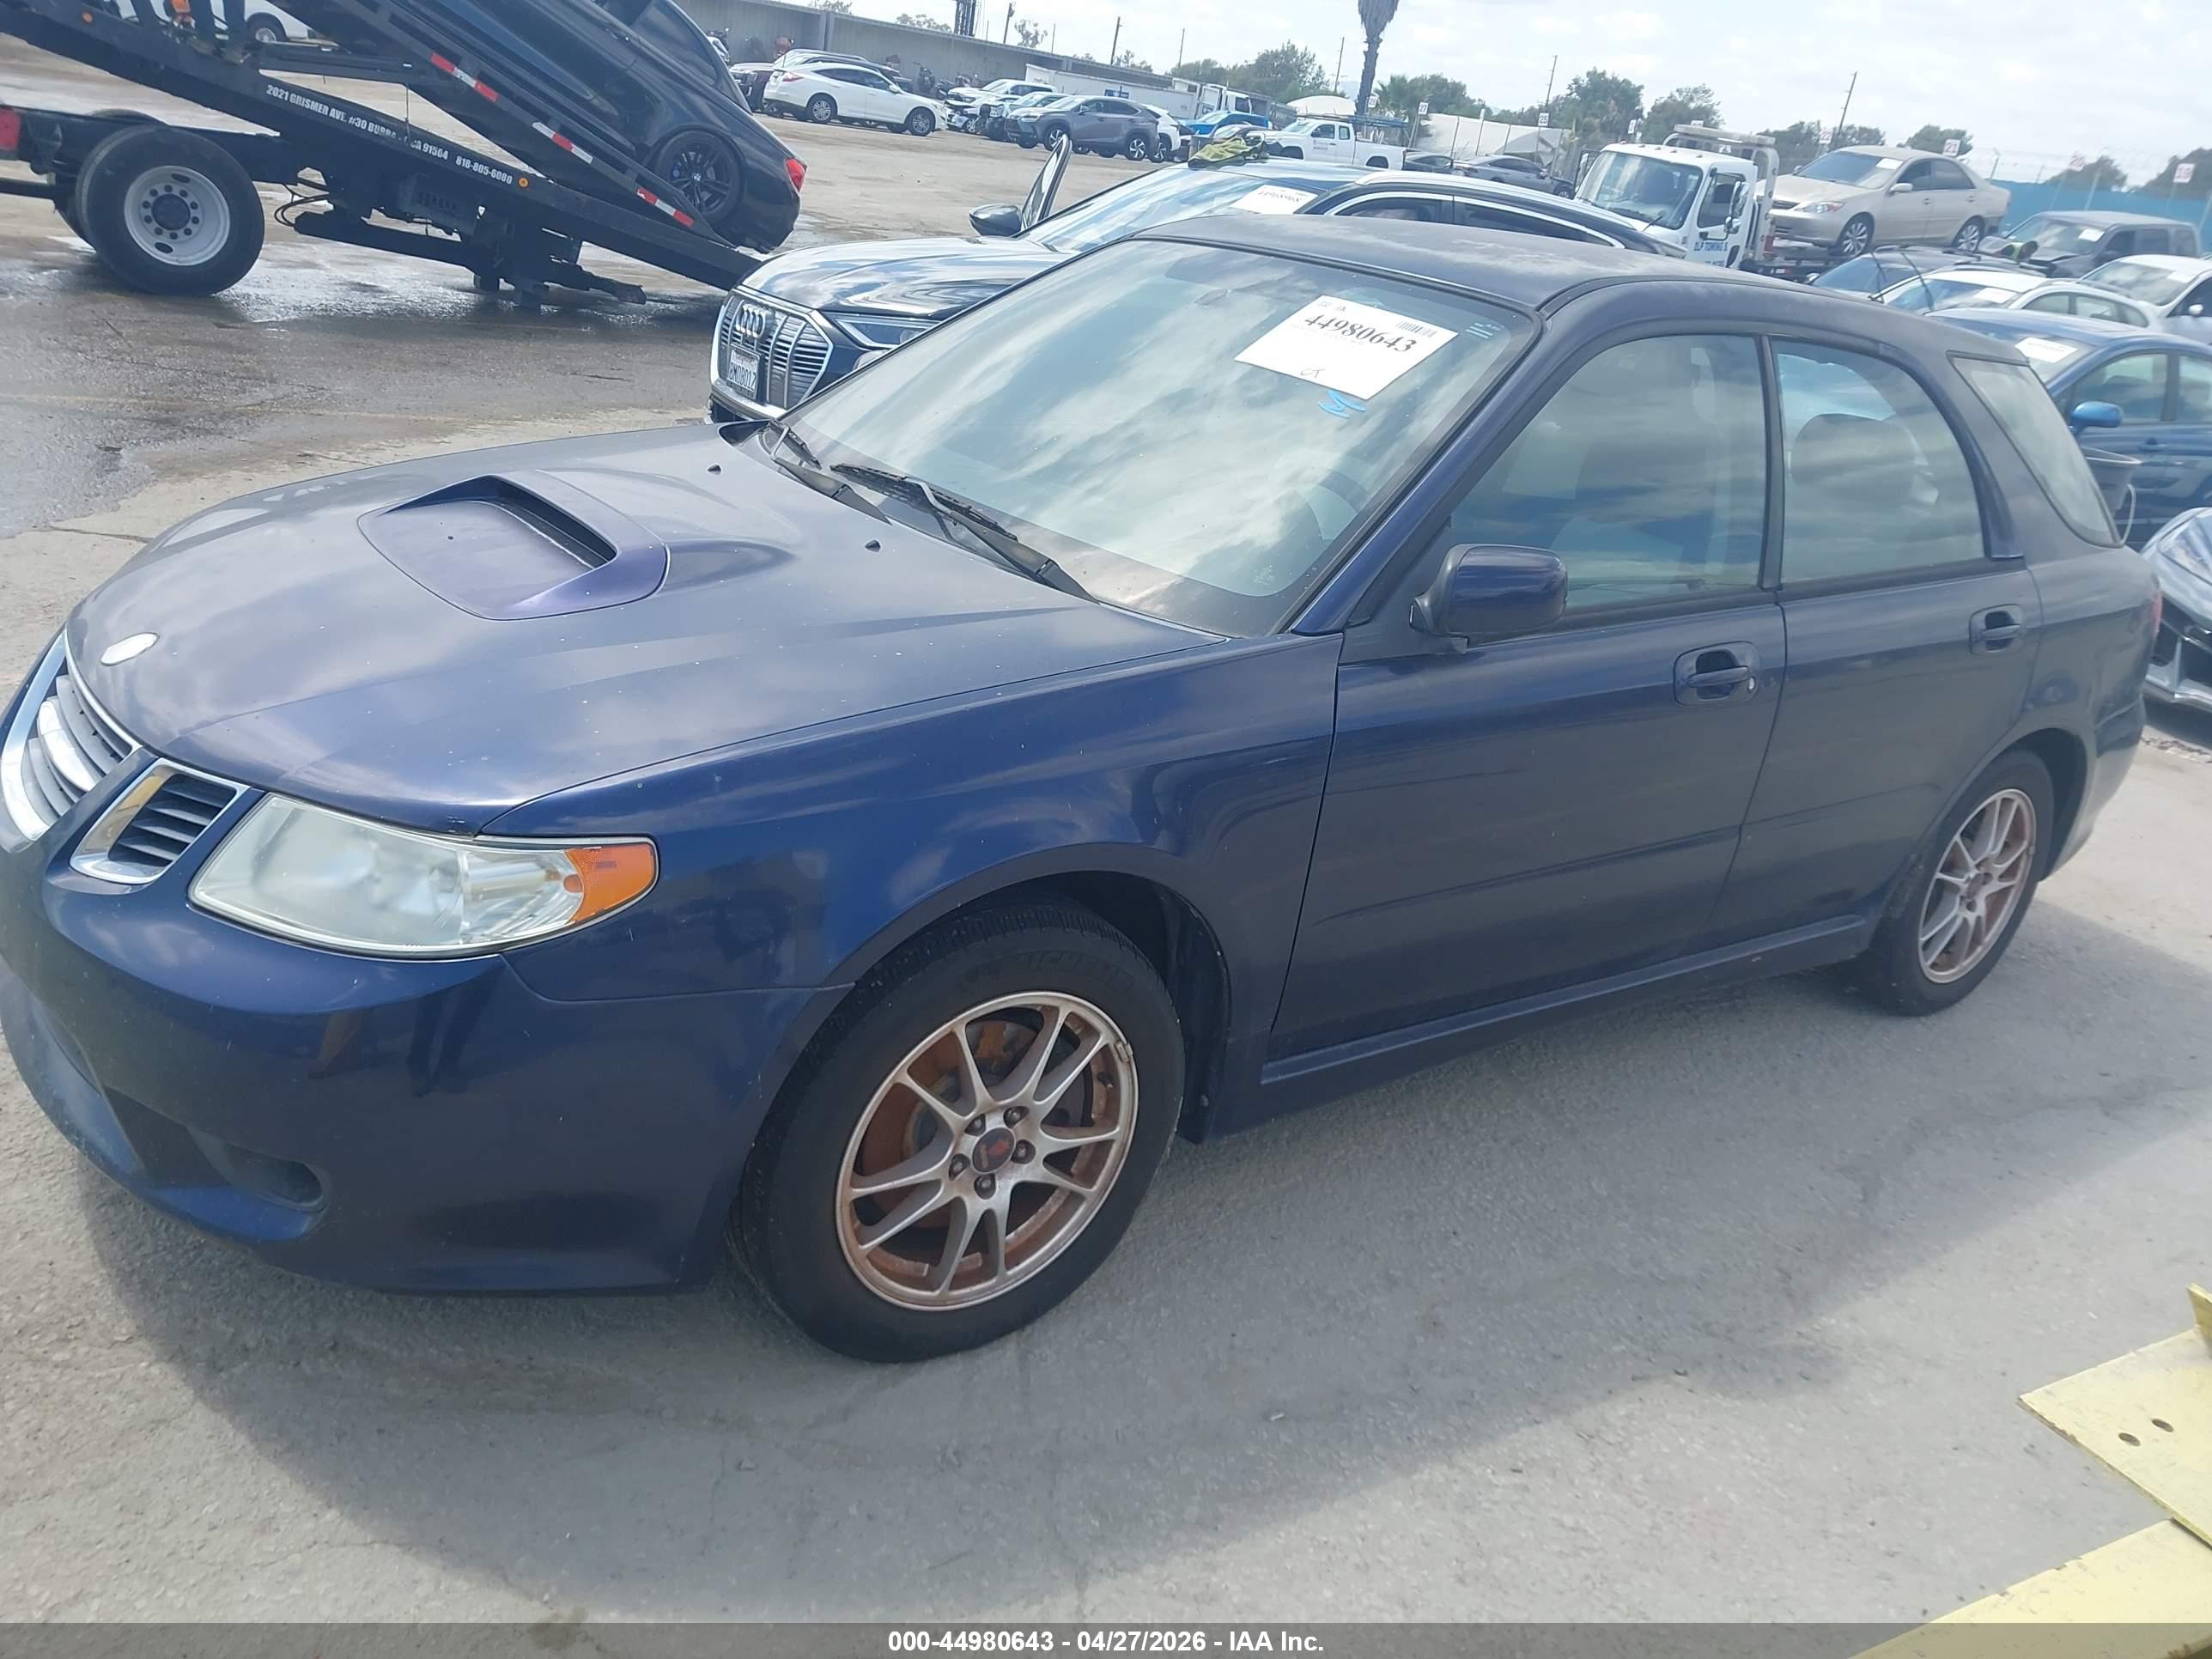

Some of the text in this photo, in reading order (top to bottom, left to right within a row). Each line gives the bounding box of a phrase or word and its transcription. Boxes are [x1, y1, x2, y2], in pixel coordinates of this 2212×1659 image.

[266, 84, 289, 100] 2021
[349, 116, 367, 130] #30
[423, 143, 449, 161] 91504
[455, 155, 514, 185] 818-805-6080
[1304, 314, 1417, 352] 44980643
